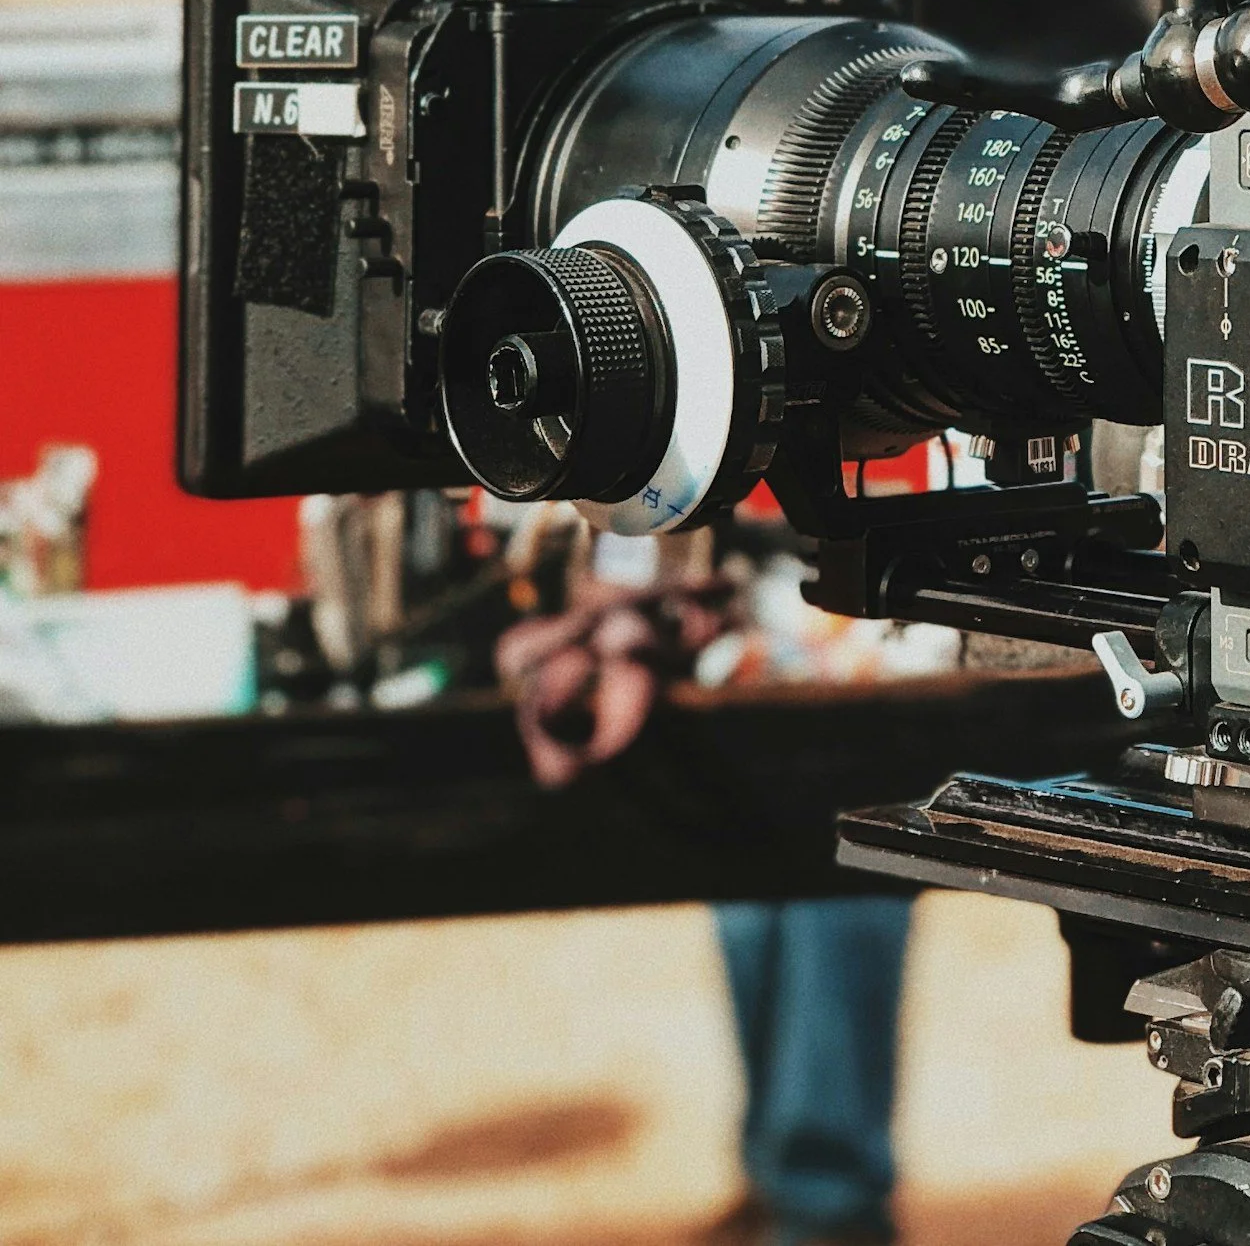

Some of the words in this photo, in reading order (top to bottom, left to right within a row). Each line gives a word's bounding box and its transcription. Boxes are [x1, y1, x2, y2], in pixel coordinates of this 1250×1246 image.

[248, 25, 344, 58] CLEAR
[981, 139, 1013, 158] 180
[875, 151, 890, 170] 6
[968, 167, 997, 187] 160
[957, 202, 985, 223] 140
[1053, 198, 1065, 215] T
[857, 236, 867, 257] 5
[952, 246, 979, 268] 120
[1047, 290, 1058, 307] 8
[957, 298, 987, 319] 100
[1044, 312, 1062, 330] 11
[978, 336, 1001, 354] 85
[1051, 333, 1070, 350] 16
[1060, 353, 1081, 367] 22
[1219, 635, 1234, 650] M3
